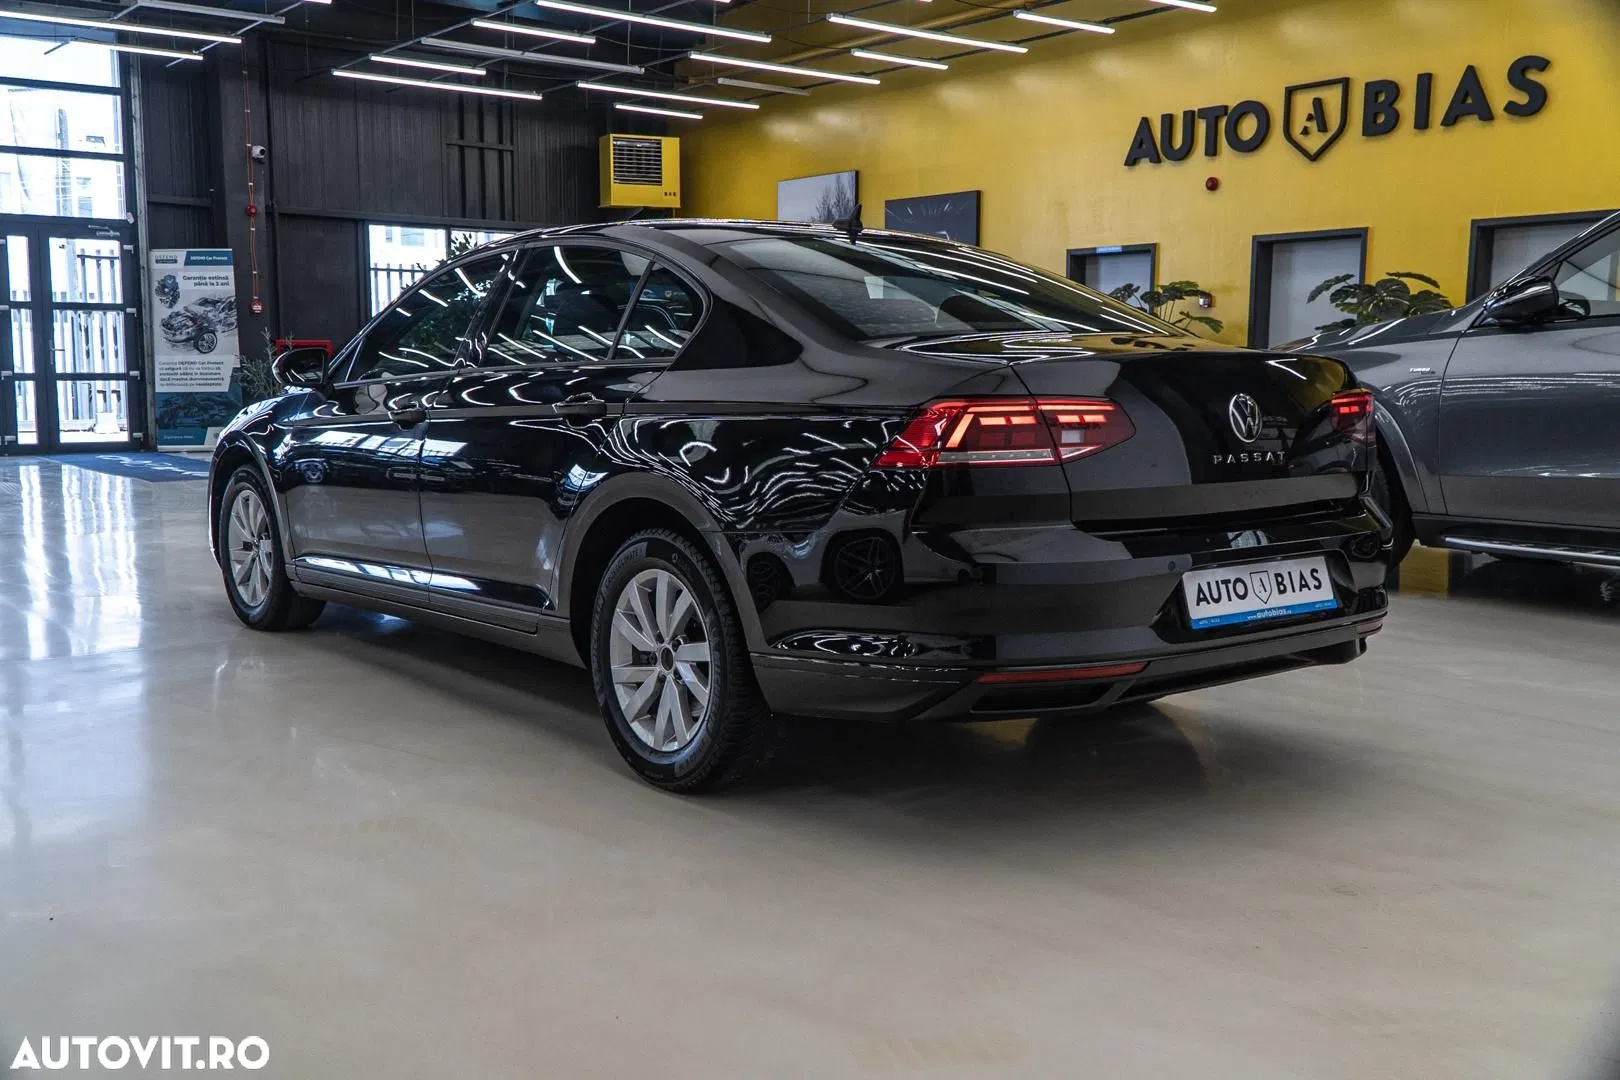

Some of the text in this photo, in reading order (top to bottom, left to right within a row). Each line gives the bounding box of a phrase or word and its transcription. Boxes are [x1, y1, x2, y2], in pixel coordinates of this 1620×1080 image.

[1123, 100, 1271, 167] AUTO
[1362, 55, 1551, 138] BIAS
[1213, 451, 1286, 465] PASSAT
[1196, 577, 1249, 606] AUTO
[1274, 568, 1323, 595] BIAS
